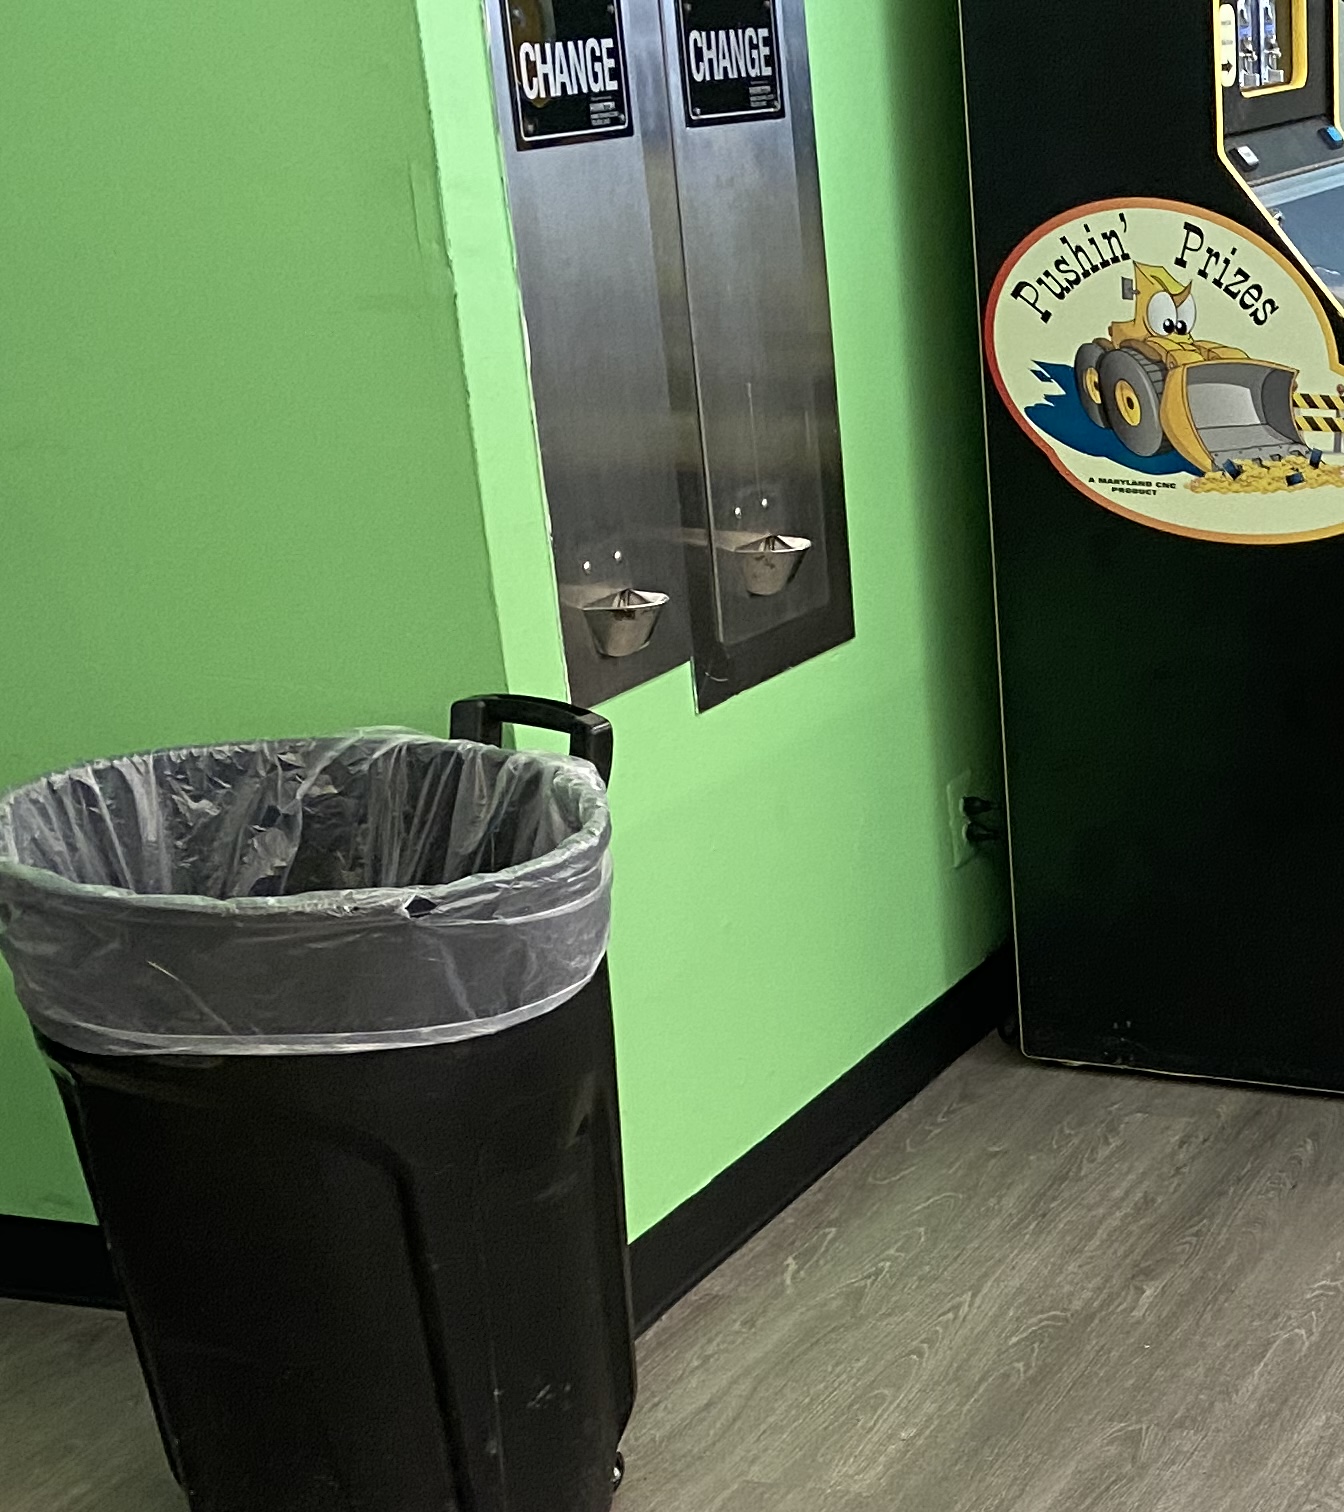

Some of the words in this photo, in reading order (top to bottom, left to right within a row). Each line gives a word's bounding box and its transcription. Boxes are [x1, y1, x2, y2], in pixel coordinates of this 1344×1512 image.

[520, 37, 618, 100] CHANGE
[689, 27, 772, 82] CHANGE
[1011, 213, 1131, 323] Pushin'
[1174, 222, 1279, 326] Prizes
[1098, 477, 1153, 488] MARYLAND
[1111, 486, 1157, 496] PRODUCT
